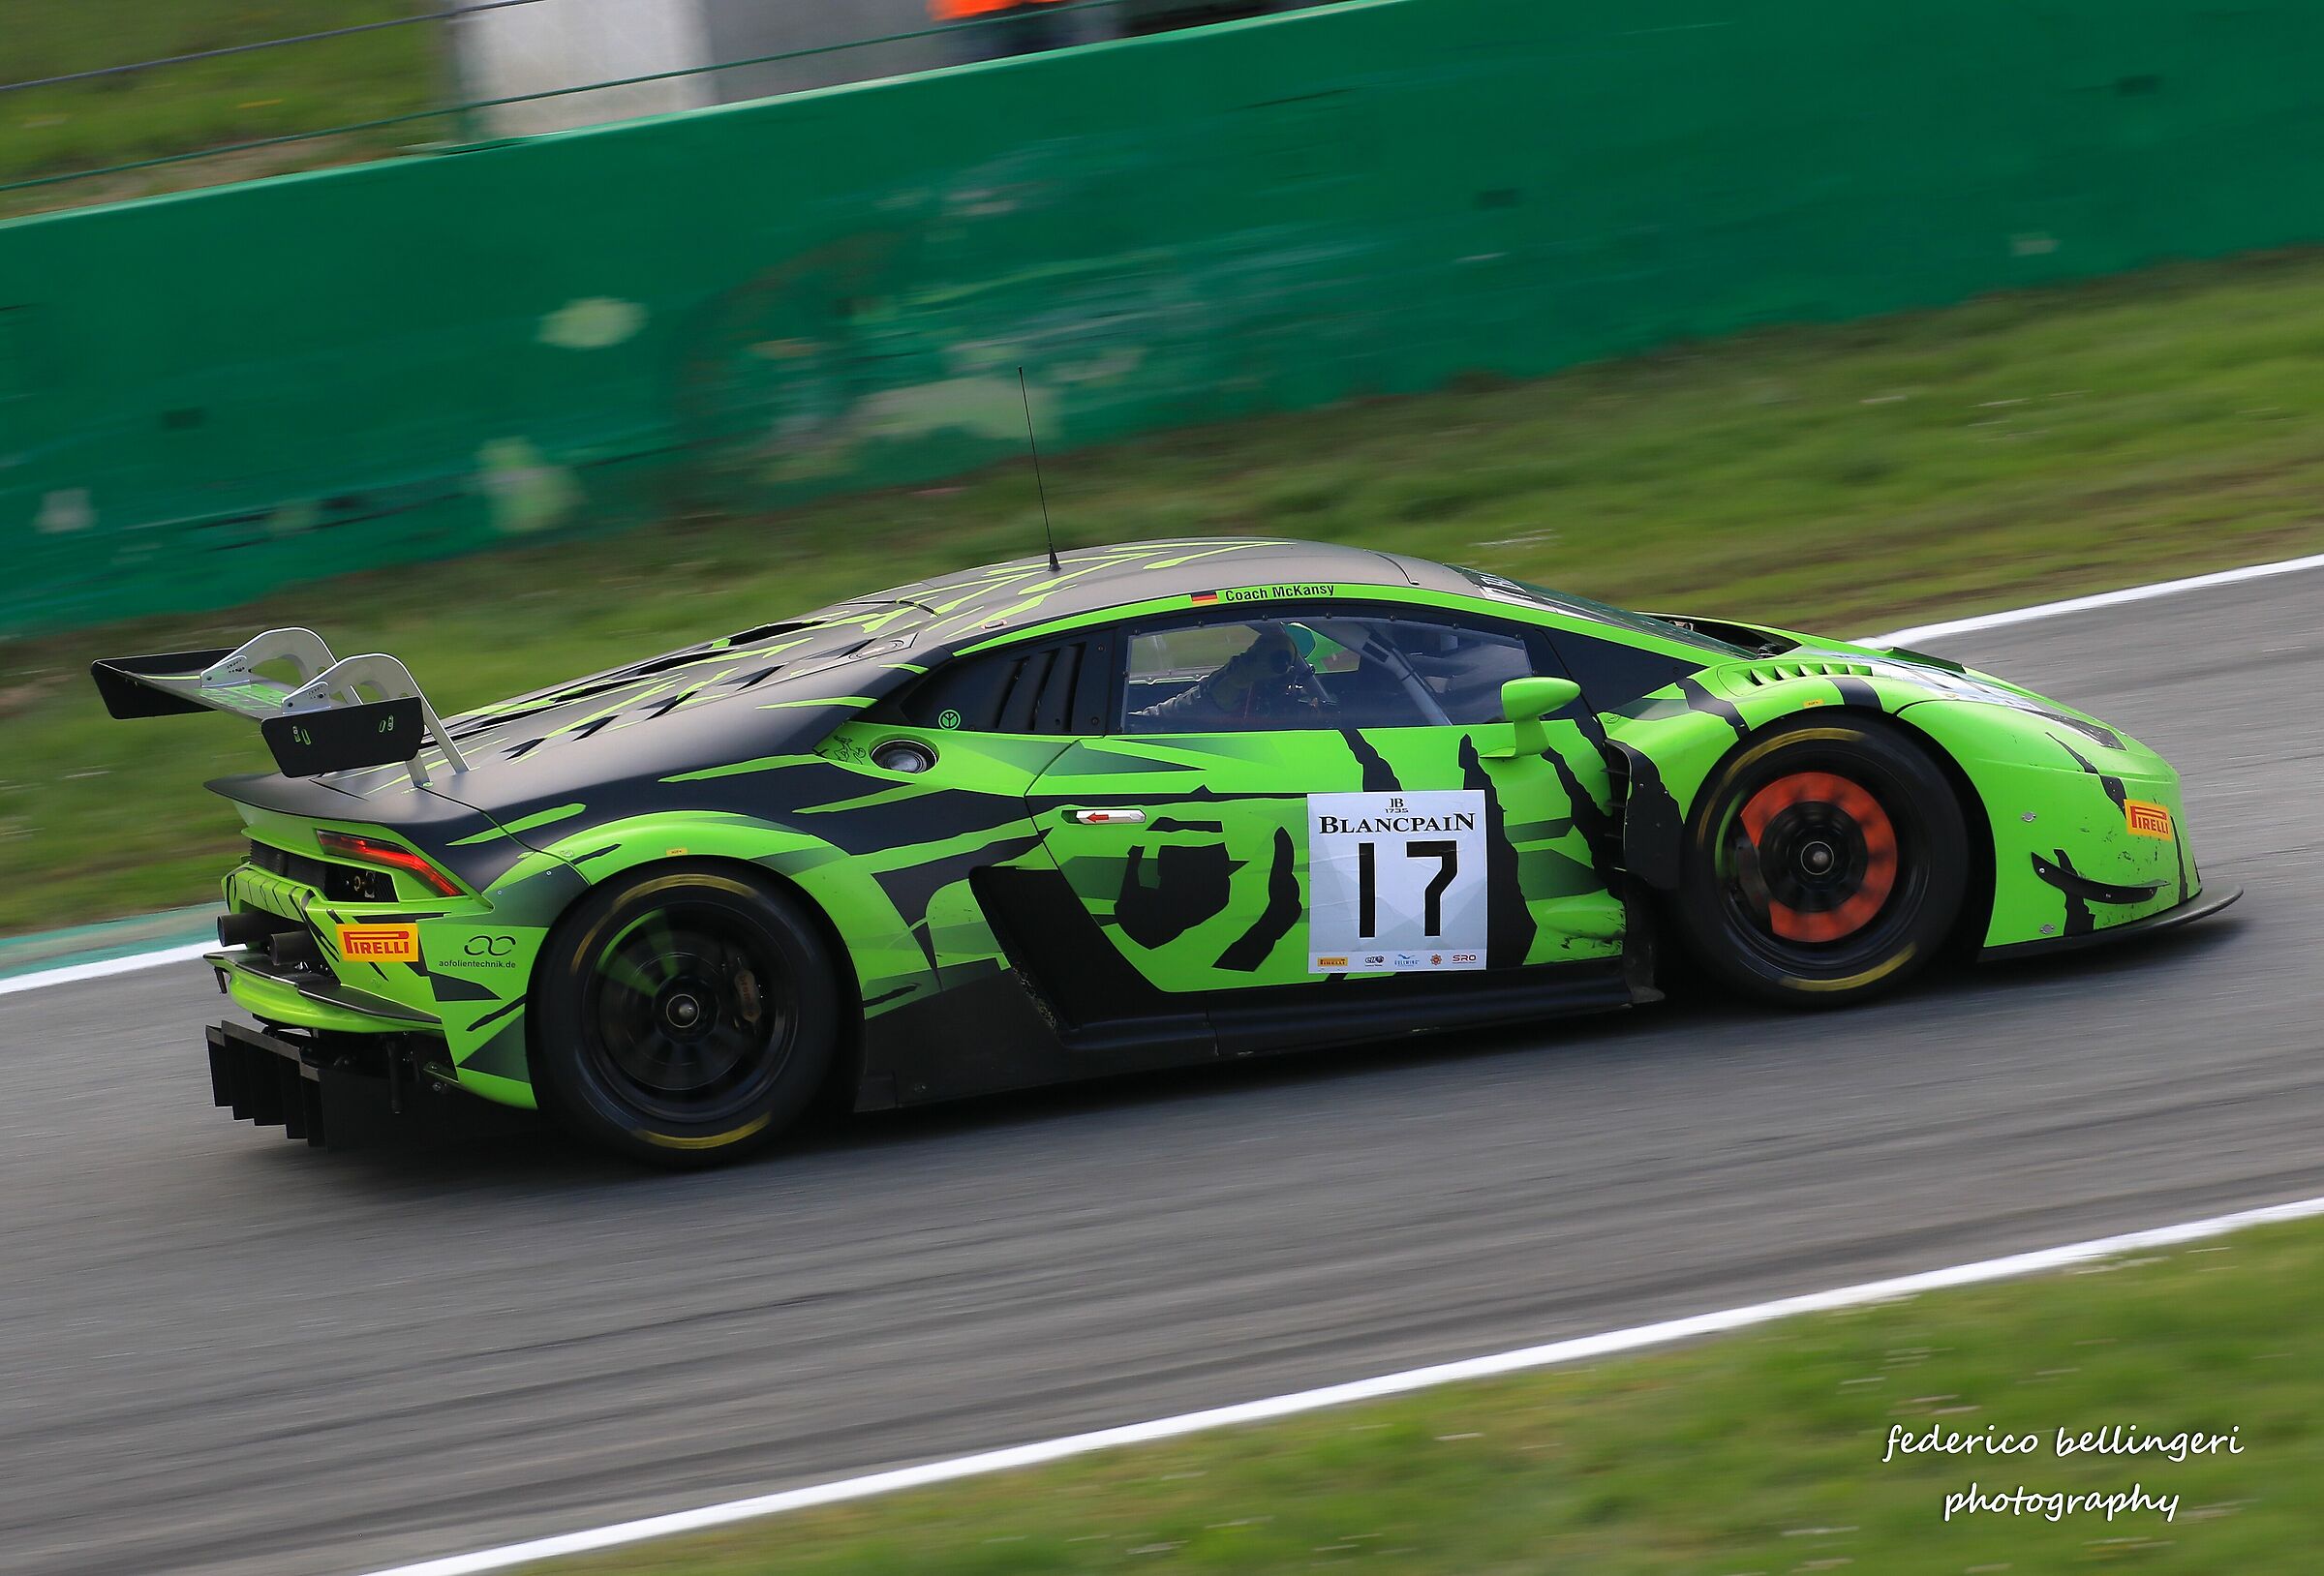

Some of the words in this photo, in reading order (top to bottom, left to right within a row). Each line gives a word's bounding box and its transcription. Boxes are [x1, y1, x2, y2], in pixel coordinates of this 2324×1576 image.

[1225, 588, 1269, 602] Coach
[1272, 585, 1334, 598] McKansy
[2130, 805, 2169, 834] PIRELLI
[1359, 840, 1457, 938] 17
[343, 930, 410, 955] PIRELLI
[439, 960, 516, 969] aofolientechnik.de
